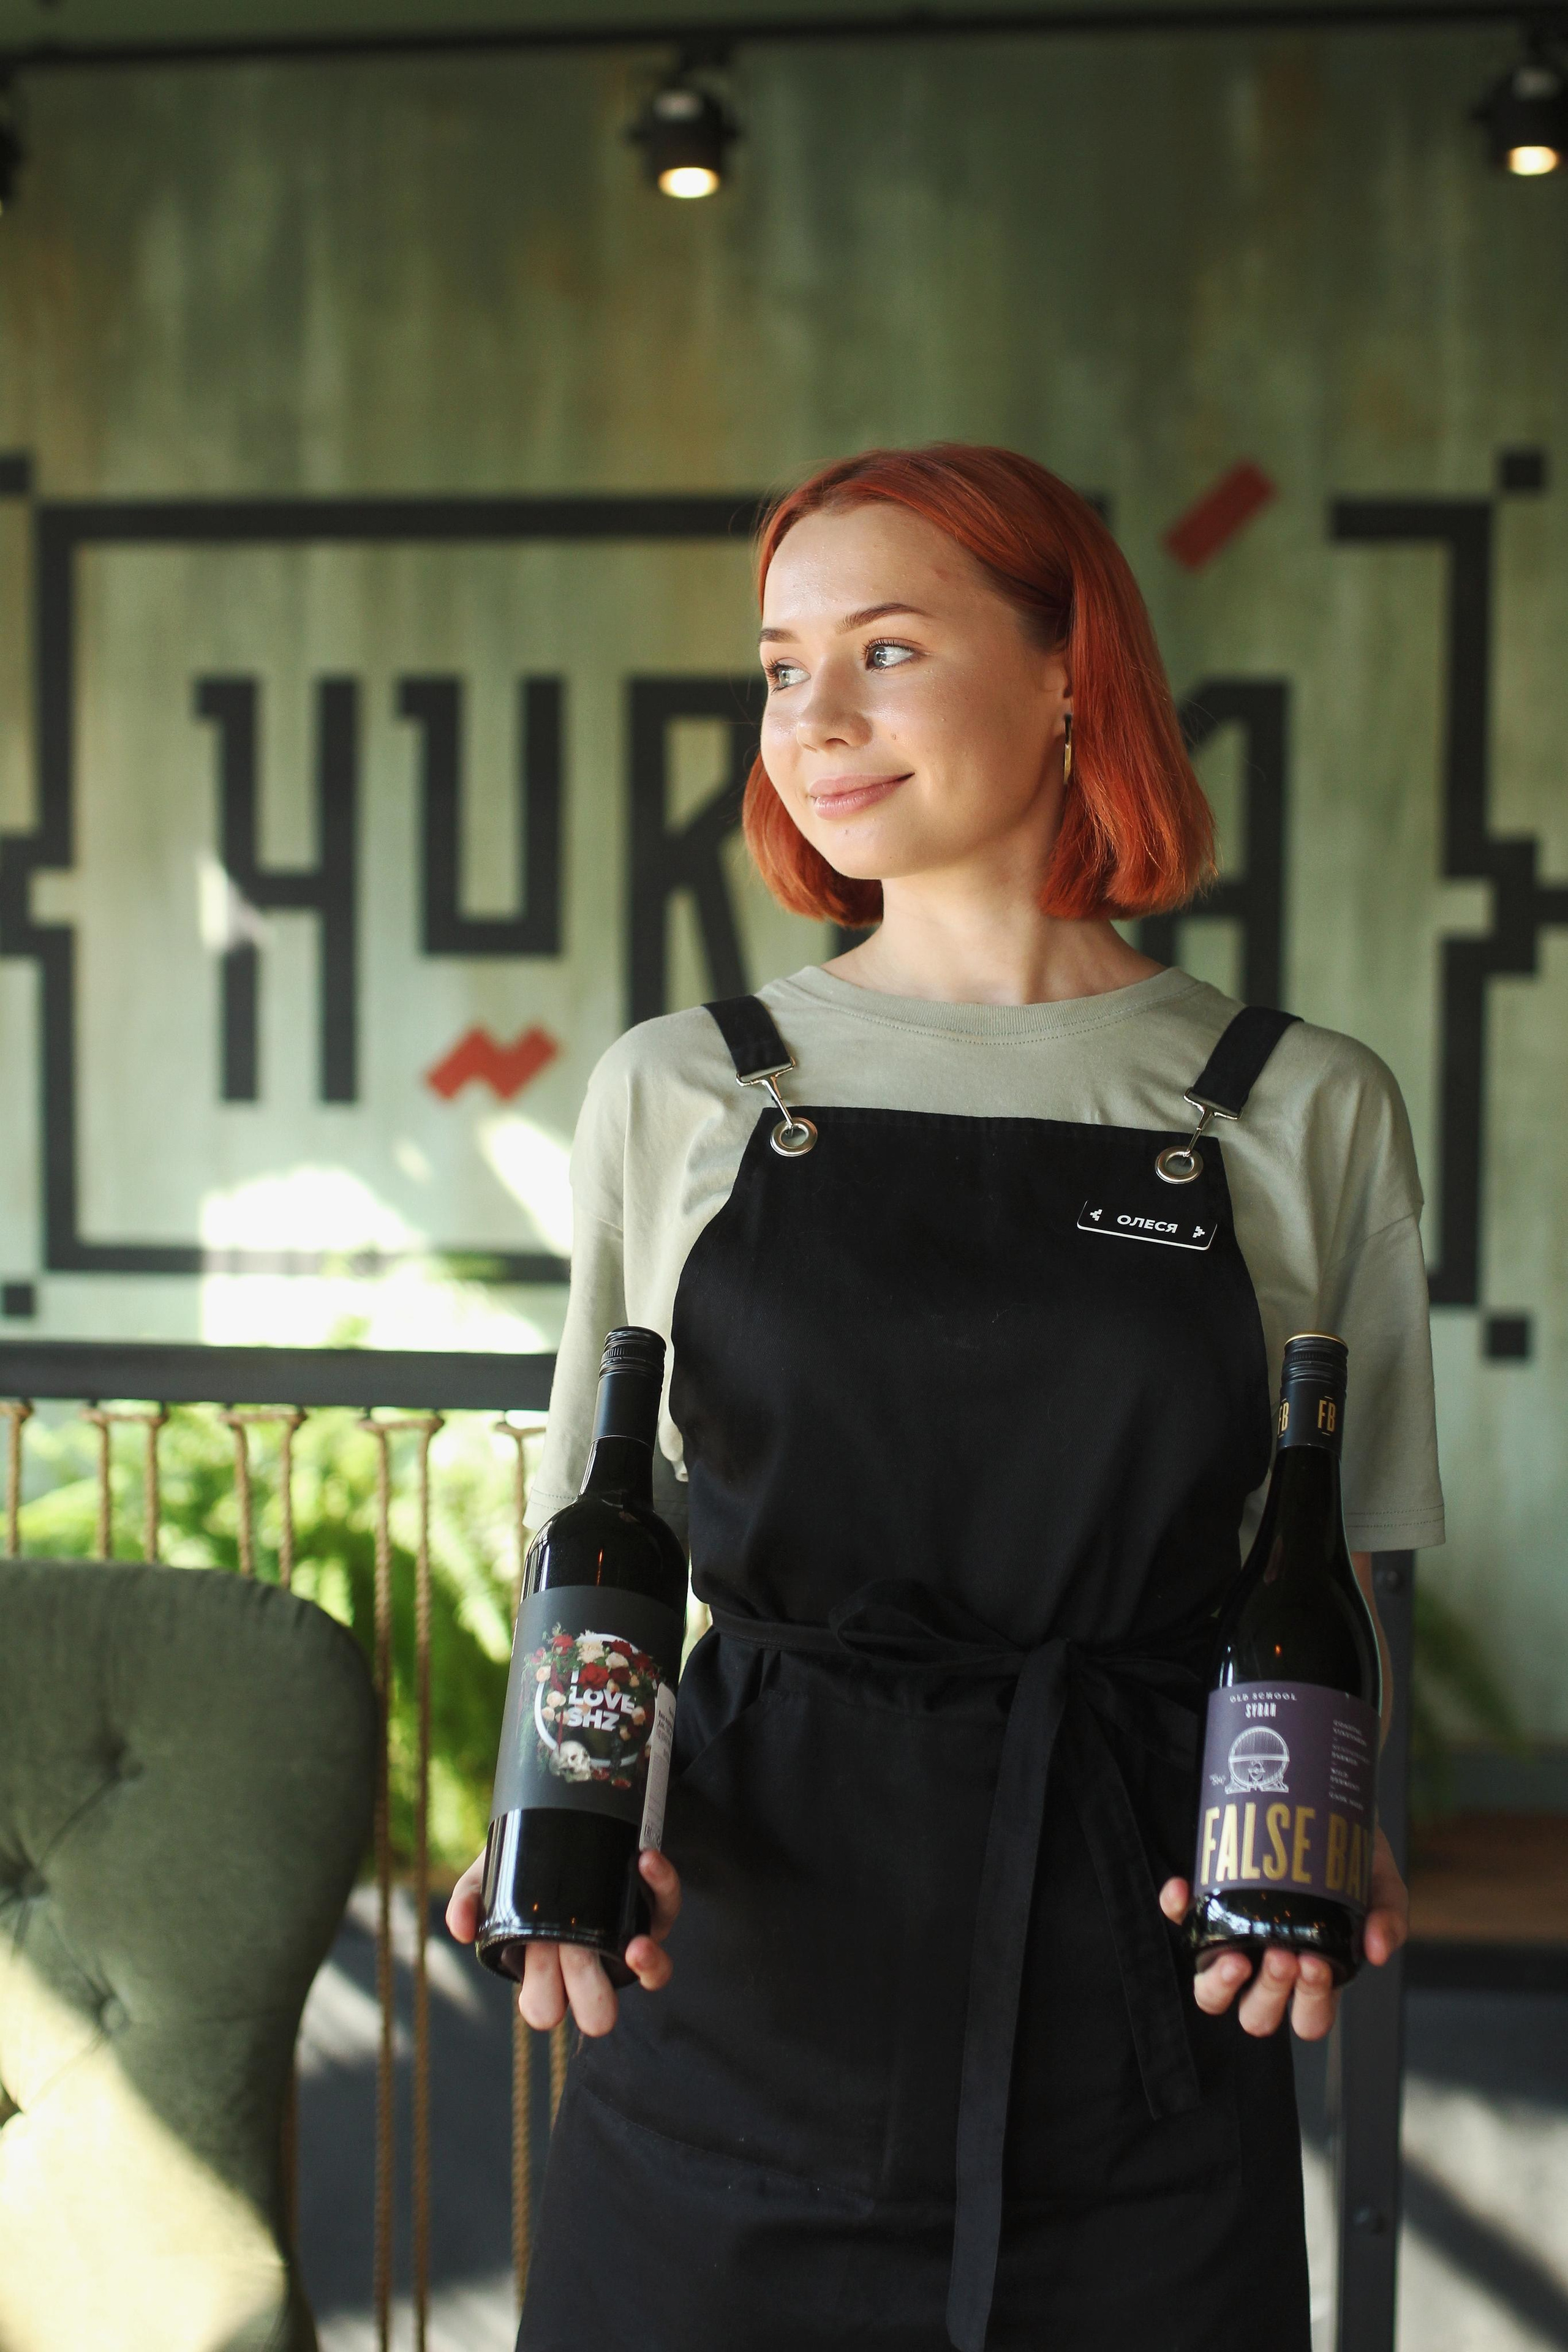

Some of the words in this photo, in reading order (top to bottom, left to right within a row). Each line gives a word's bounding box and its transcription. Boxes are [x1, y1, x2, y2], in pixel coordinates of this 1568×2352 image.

[196, 675, 1290, 1104] HURA
[1117, 1215, 1178, 1234] ОЛЕСЯ
[1317, 1400, 1336, 1431] FB
[568, 1685, 636, 1714] LOVE
[1229, 1693, 1249, 1703] OLD
[1252, 1692, 1297, 1701] SCHOOL
[1245, 1702, 1277, 1718] SYRAH
[567, 1706, 620, 1732] SHZ
[1200, 1801, 1316, 1886] FALSE
